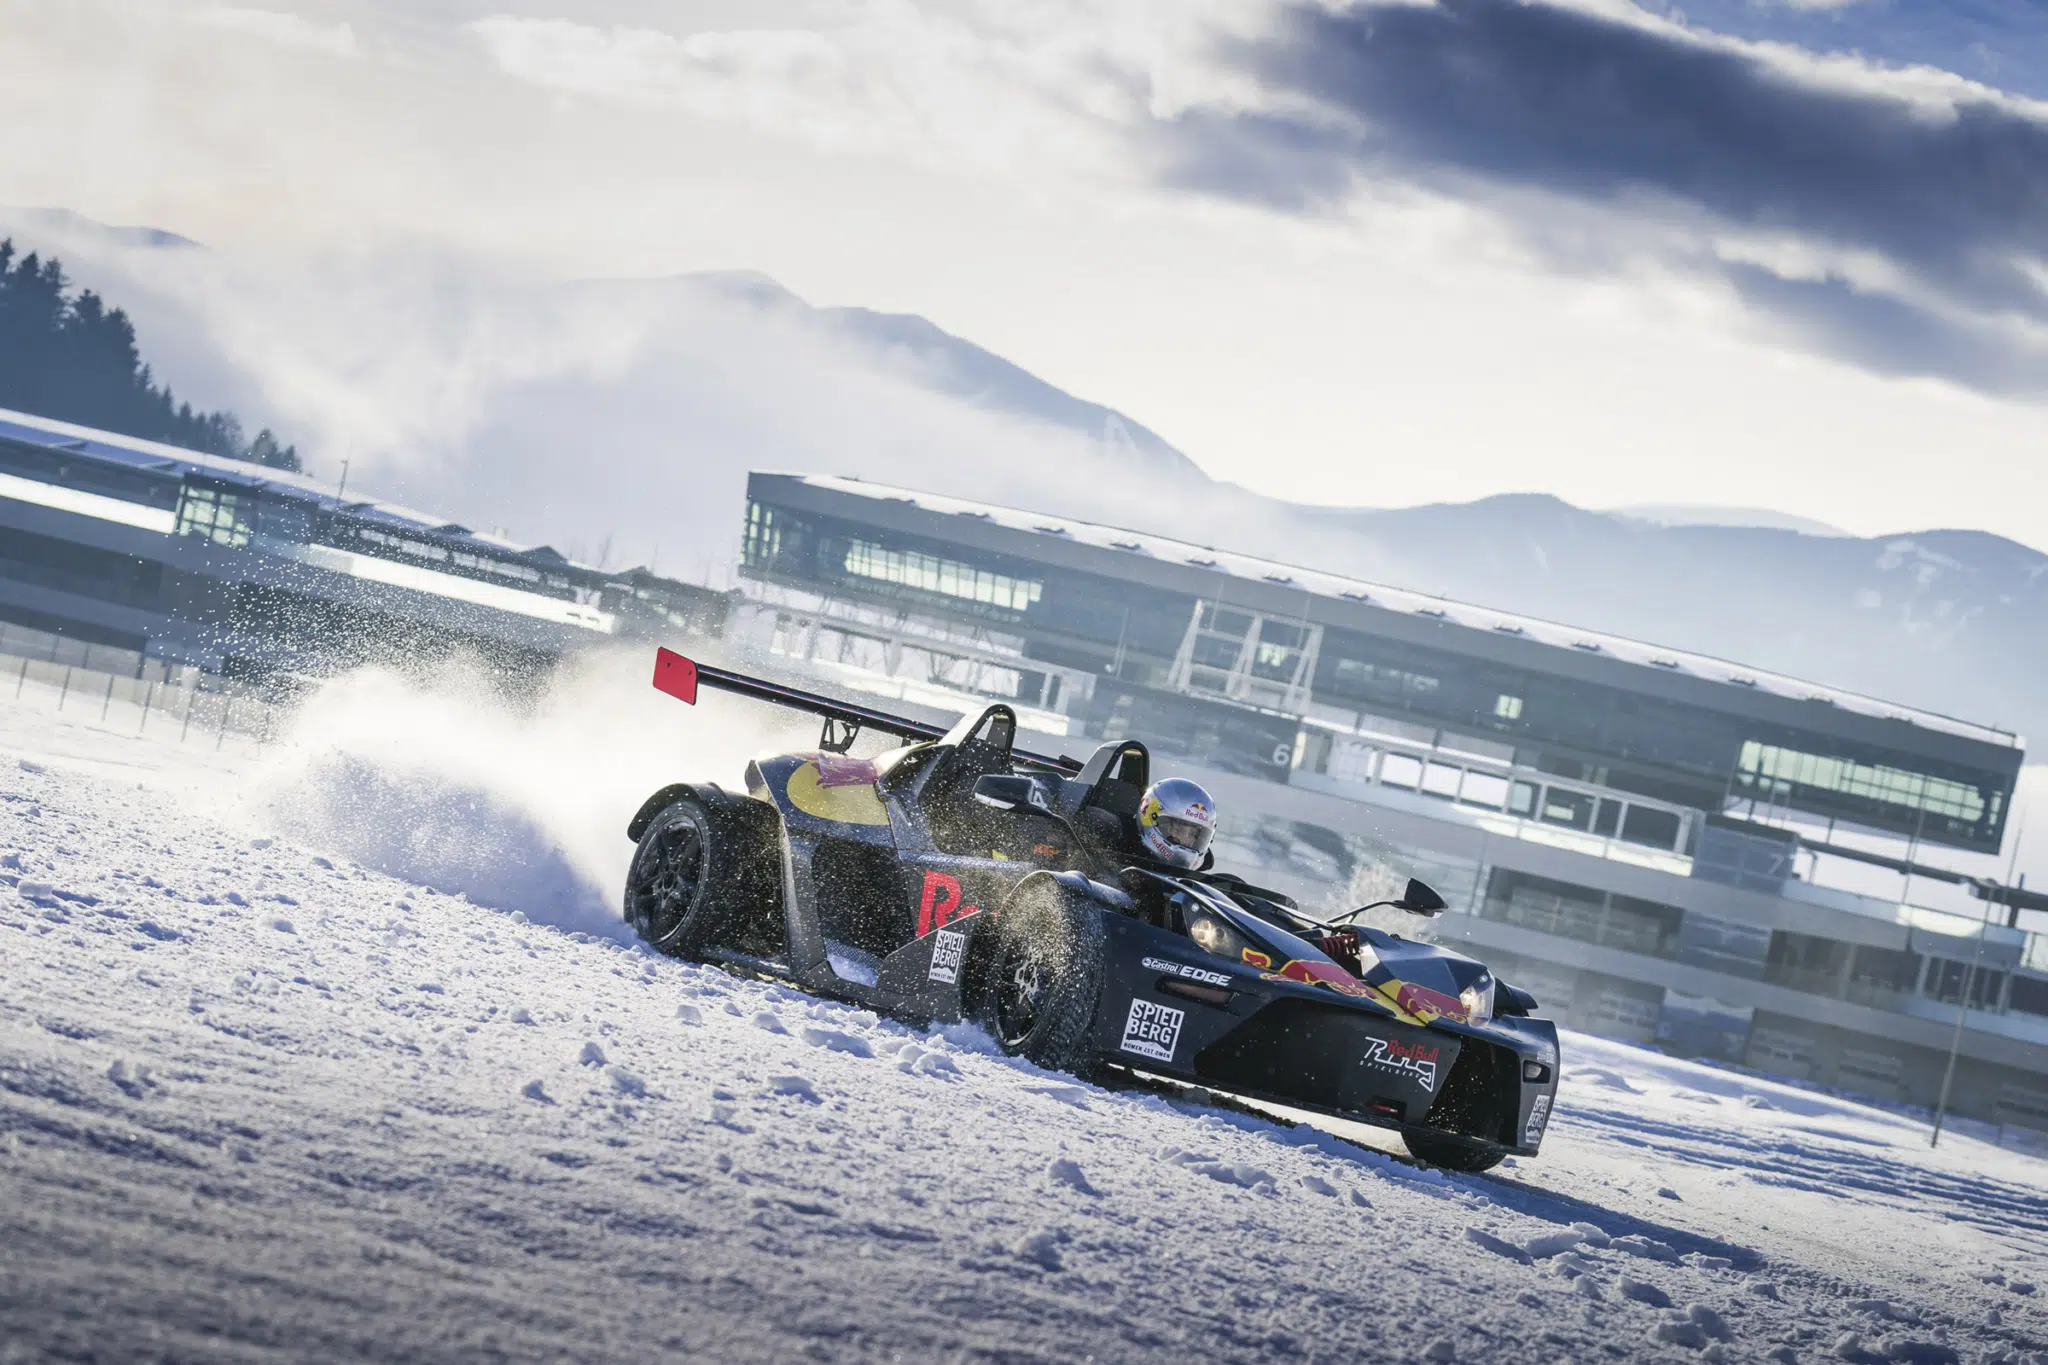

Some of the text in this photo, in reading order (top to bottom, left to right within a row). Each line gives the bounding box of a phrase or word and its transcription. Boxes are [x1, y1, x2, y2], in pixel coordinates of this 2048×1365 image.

[1272, 743, 1290, 766] 6
[1149, 833, 1176, 861] Red Bull
[936, 931, 963, 952] SPIEL
[933, 948, 958, 968] BERG
[1151, 960, 1233, 987] Castrol EDGE
[1131, 1002, 1180, 1029] SPIEL
[1127, 1018, 1173, 1045] BERG
[1387, 1039, 1440, 1062] Red Bull
[1359, 1059, 1421, 1079] SPIELBERG
